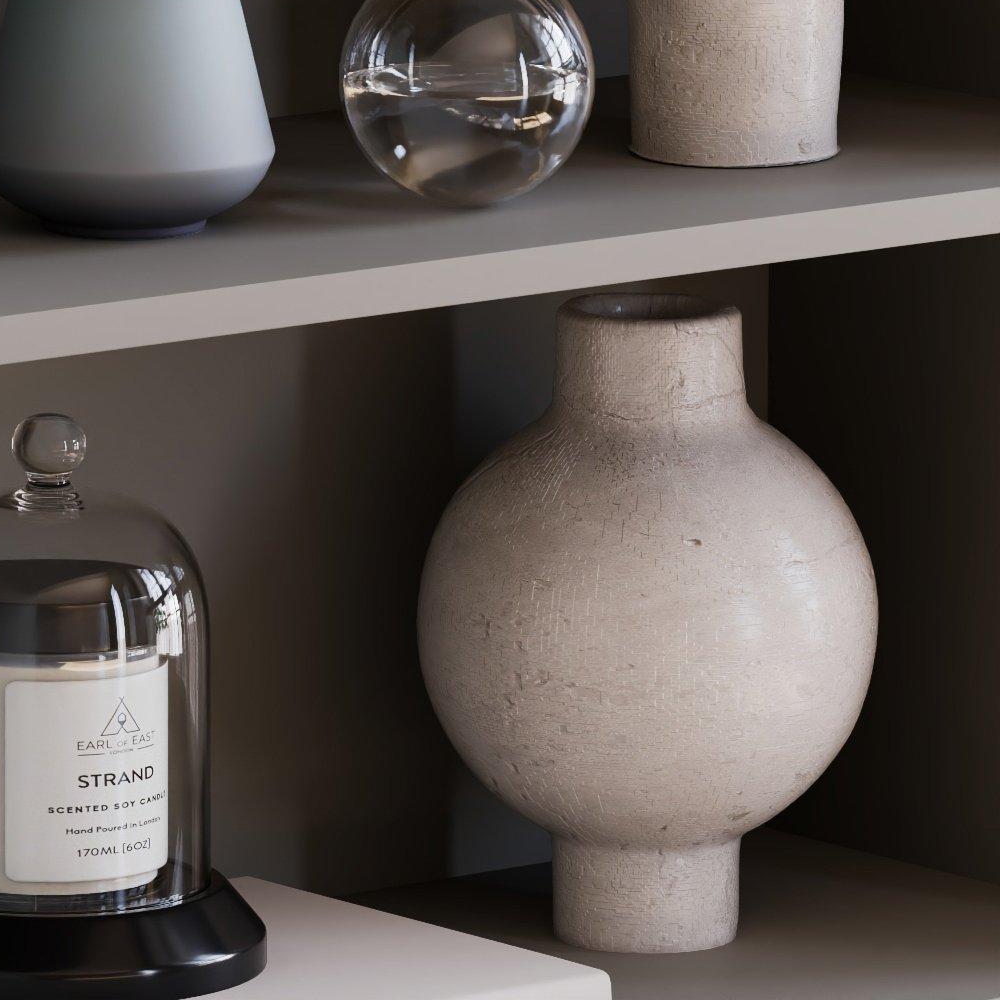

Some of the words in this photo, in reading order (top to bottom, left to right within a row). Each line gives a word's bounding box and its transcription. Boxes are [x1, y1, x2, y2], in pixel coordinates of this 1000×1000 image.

[77, 739, 113, 751] EARL
[77, 765, 154, 788] STRAND
[48, 804, 109, 814] SCENTED
[114, 801, 136, 810] SOY
[65, 827, 94, 836] Hand
[96, 821, 128, 833] Poured
[77, 845, 120, 858] 170ML
